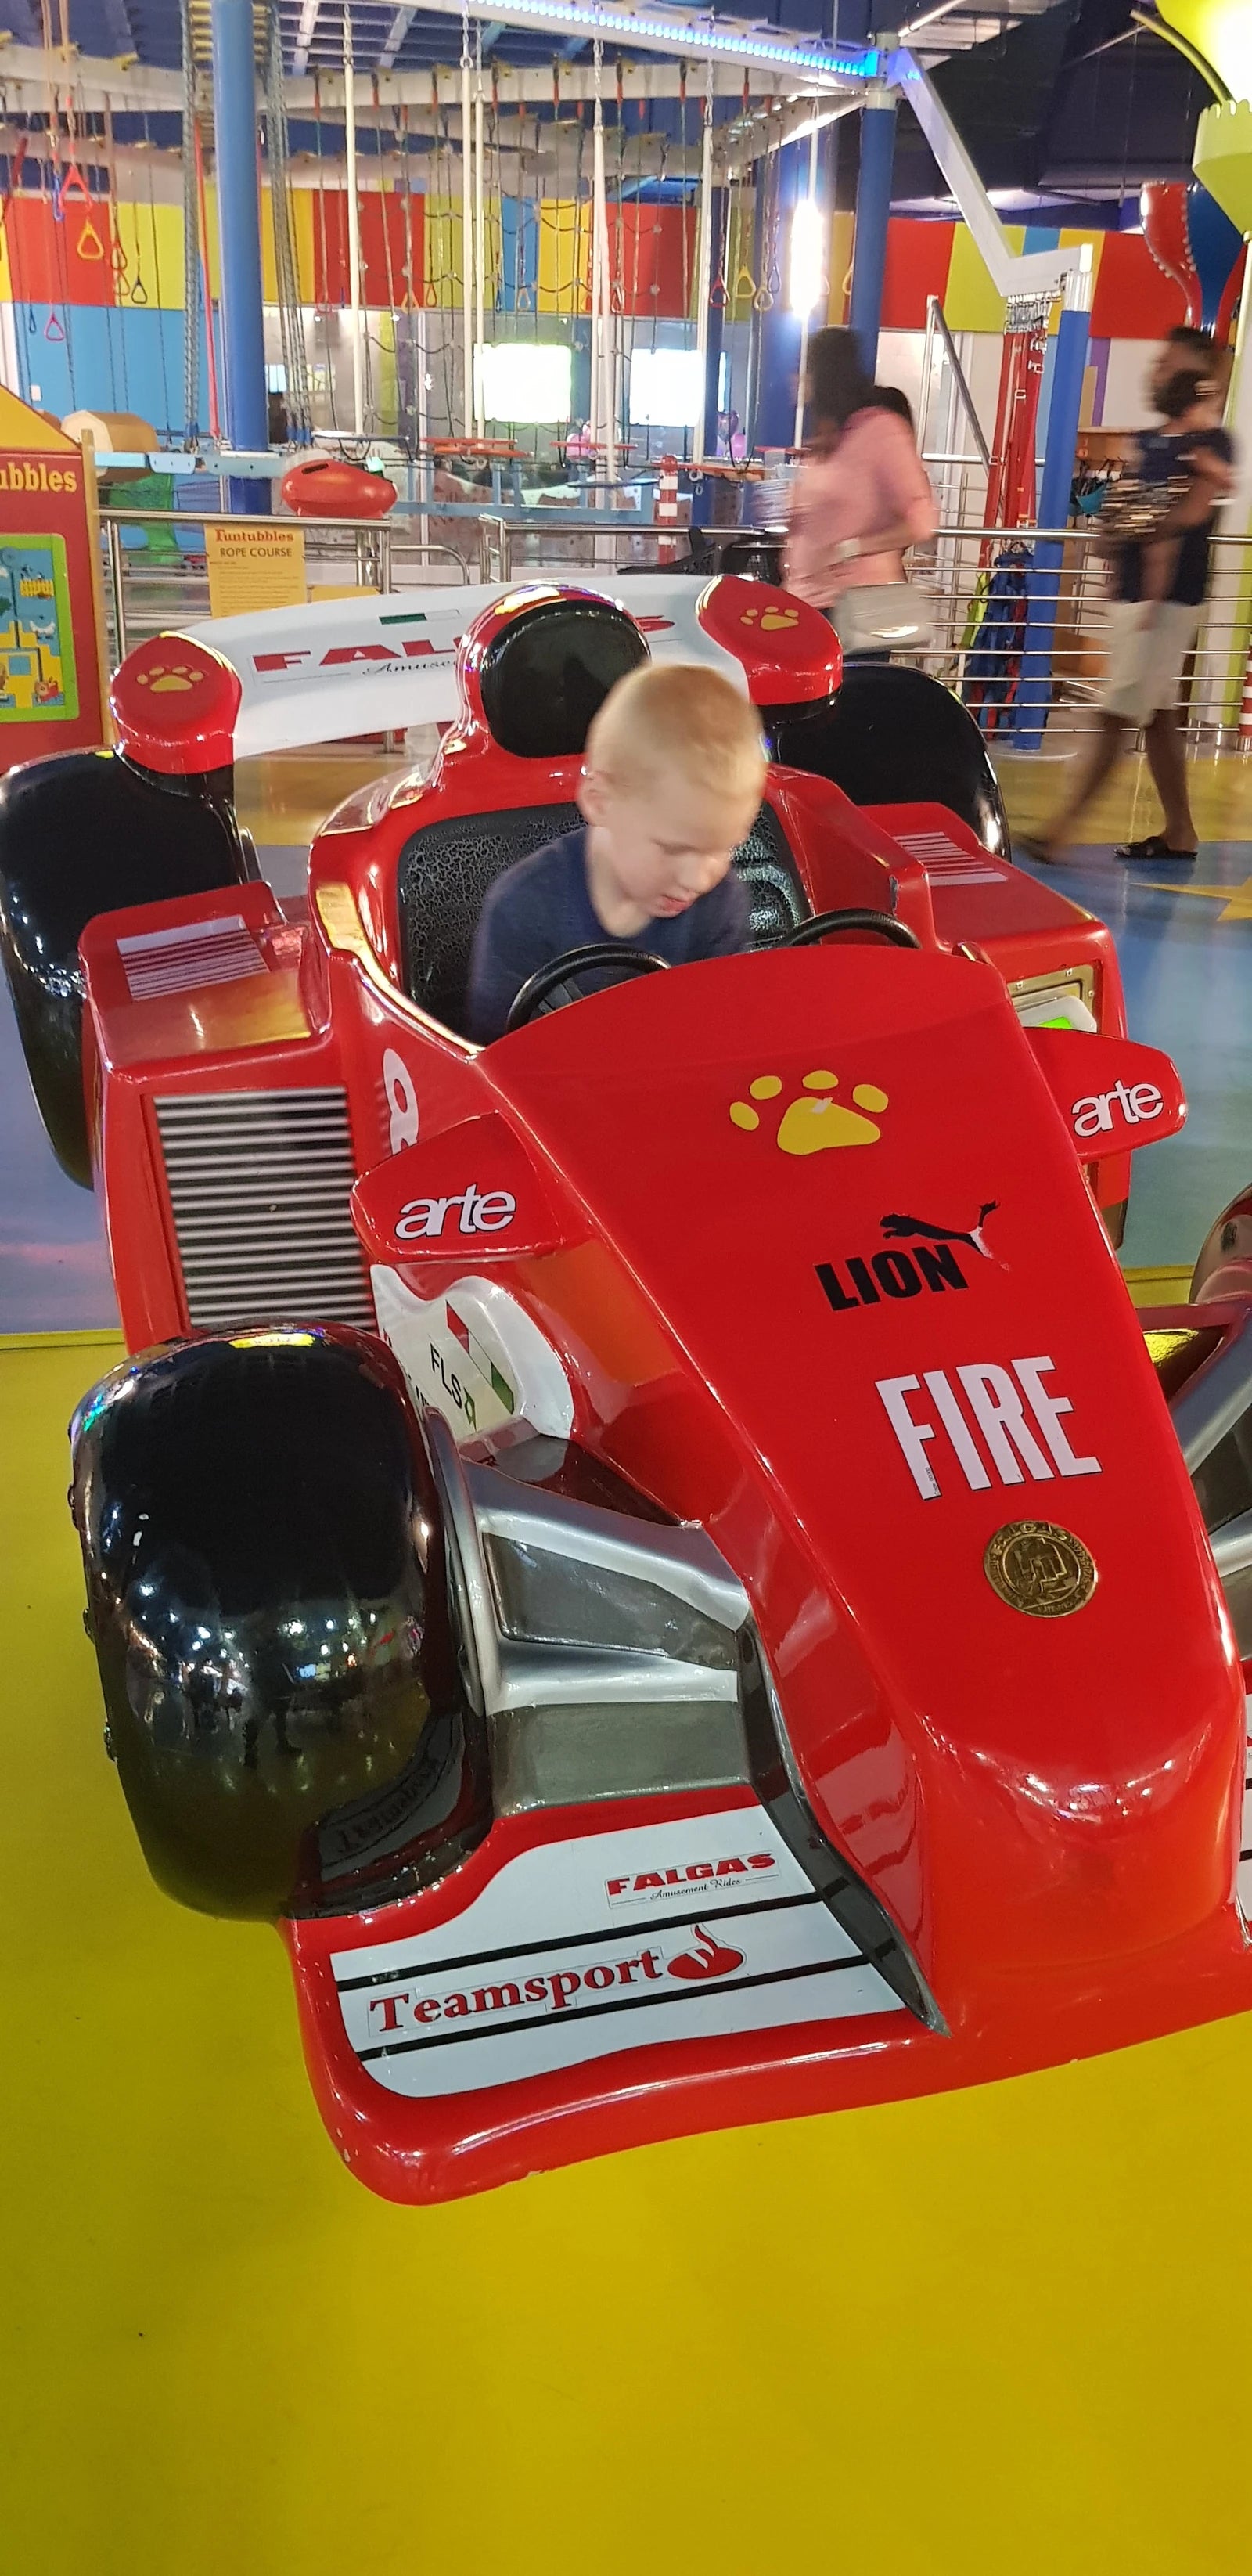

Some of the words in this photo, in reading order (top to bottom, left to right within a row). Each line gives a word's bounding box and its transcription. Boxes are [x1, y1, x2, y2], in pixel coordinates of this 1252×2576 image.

[219, 547, 247, 557] ROPE
[250, 547, 293, 557] COURSE
[1071, 1079, 1164, 1137] arte
[394, 1183, 516, 1241] arte
[814, 1243, 969, 1311] LION
[874, 1355, 1103, 1501] FIRE
[606, 1852, 776, 1896] FALGAS
[649, 1883, 708, 1900] Amusement
[709, 1878, 741, 1890] Rides
[369, 1949, 664, 2032] Teamsport
